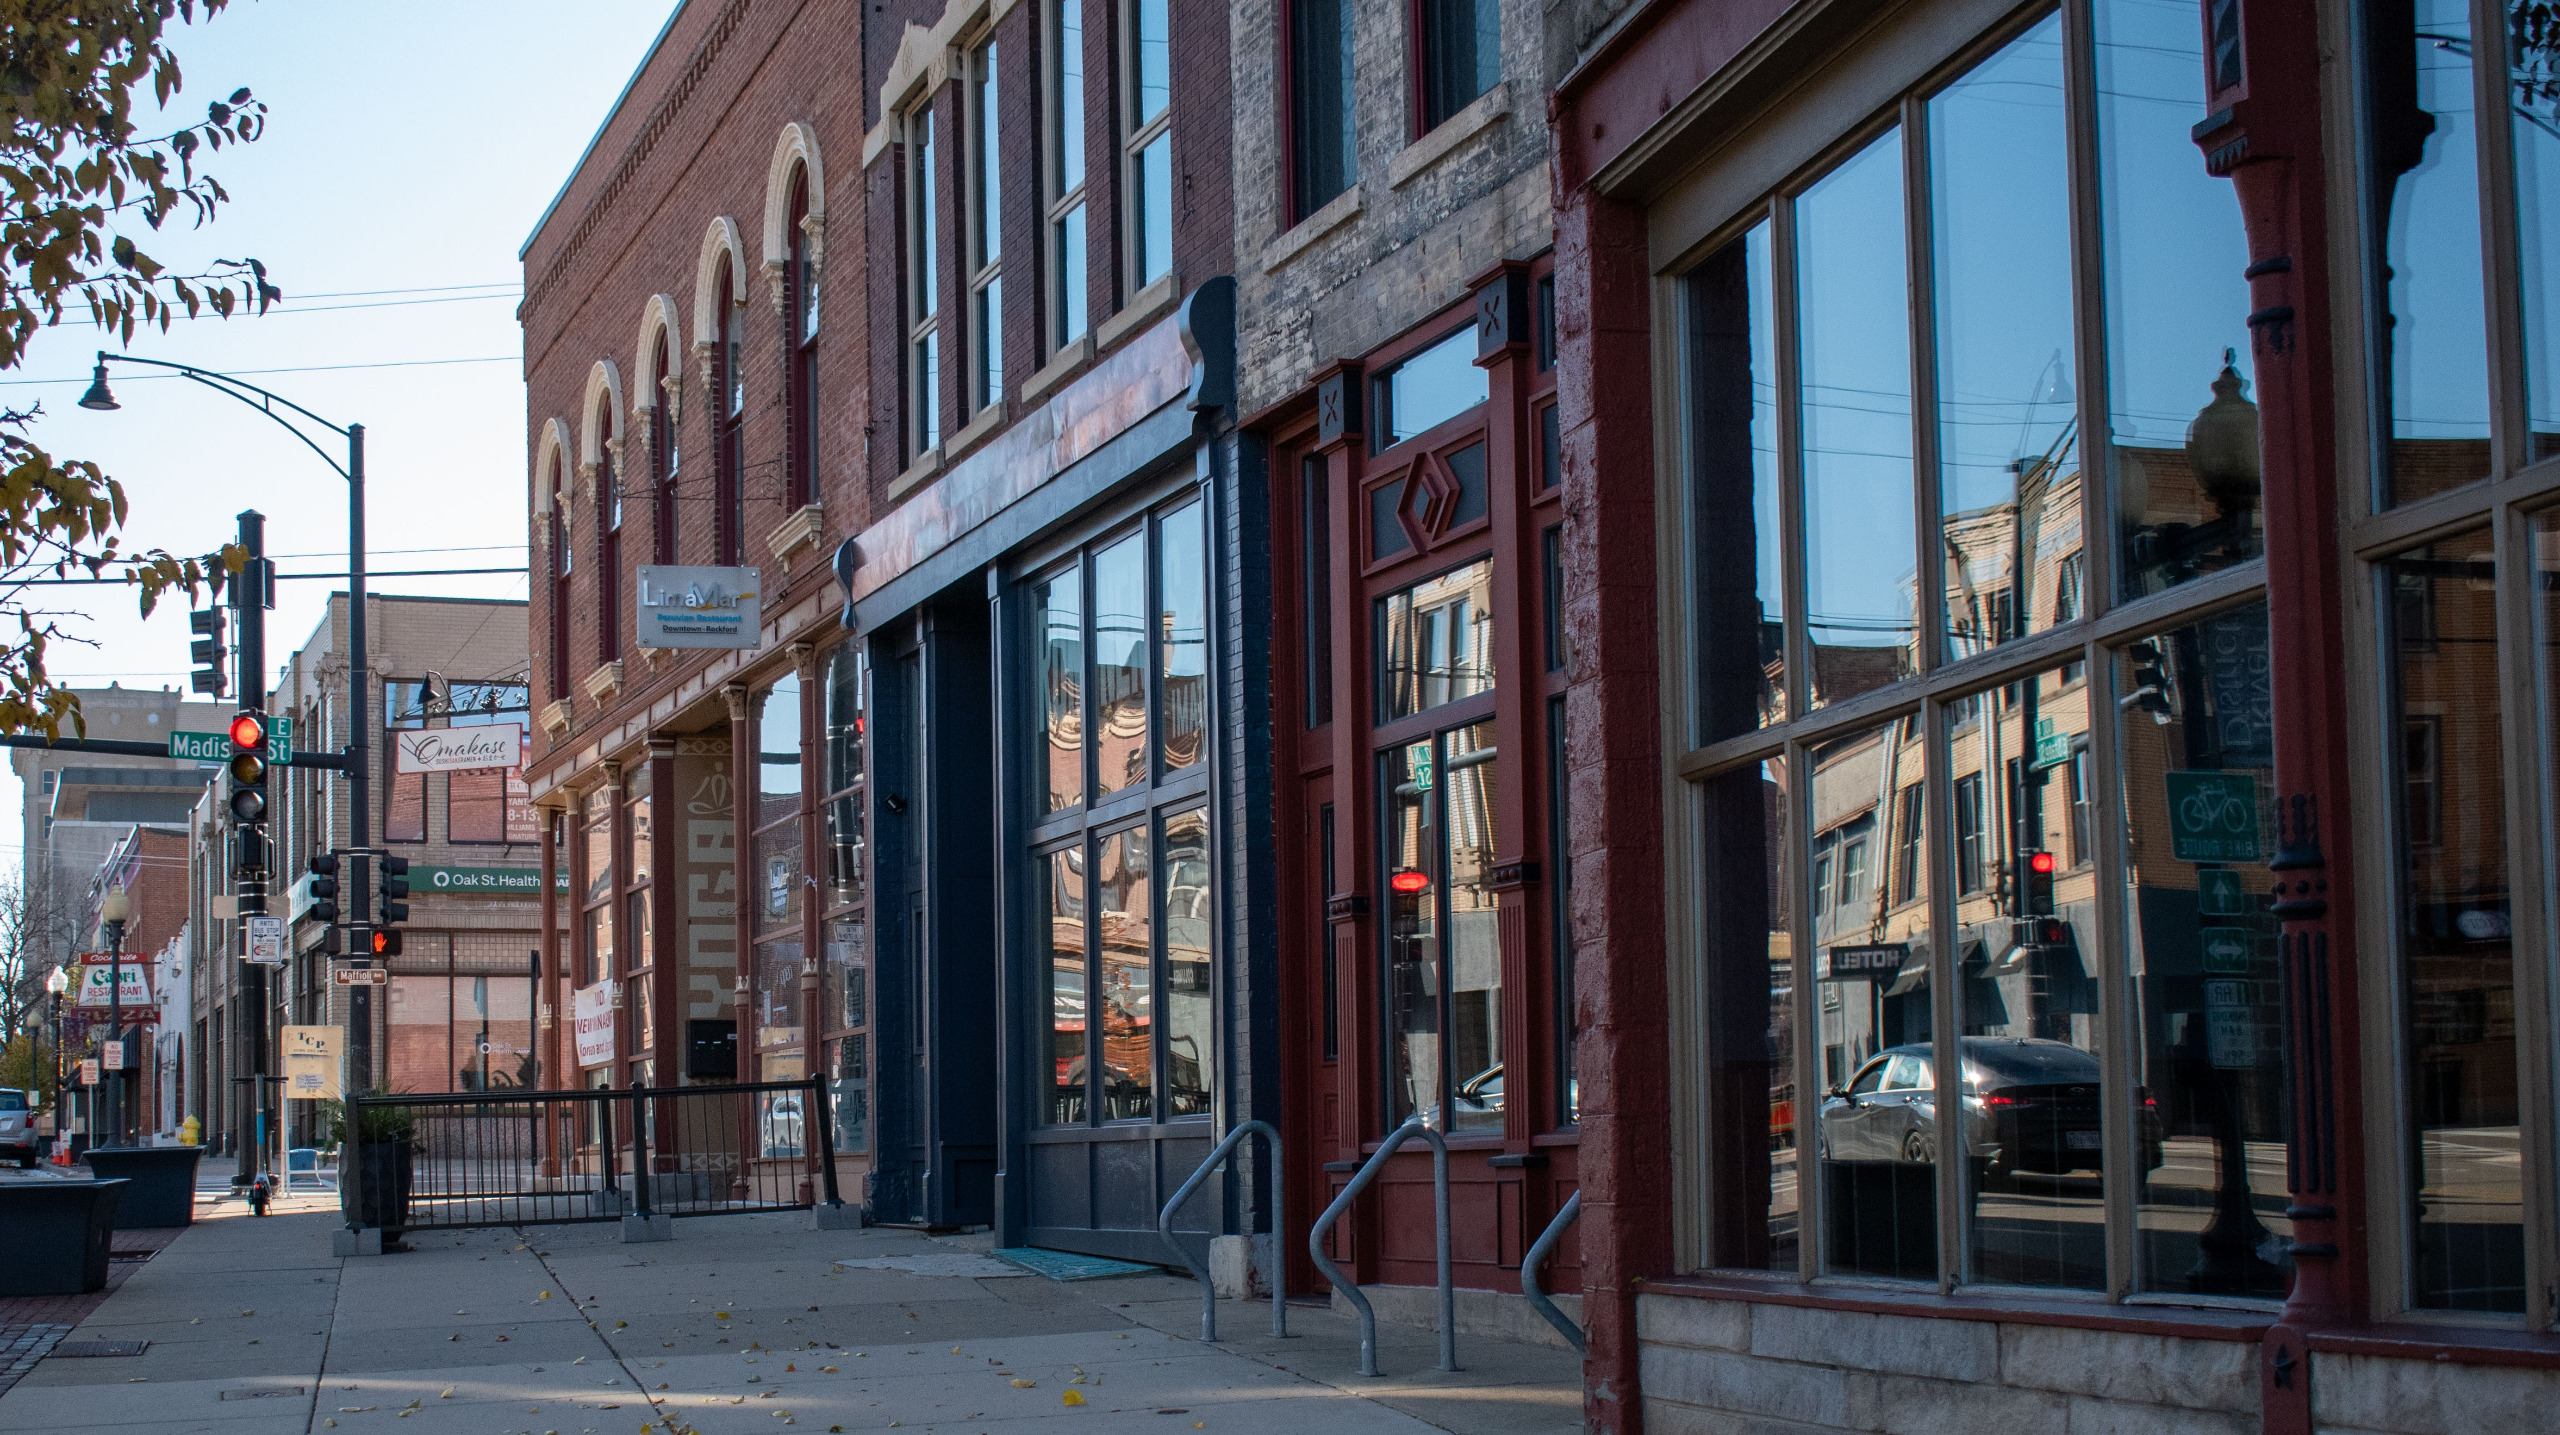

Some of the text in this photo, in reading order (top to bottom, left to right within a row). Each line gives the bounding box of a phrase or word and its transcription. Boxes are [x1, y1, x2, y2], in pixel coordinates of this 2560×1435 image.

[657, 613, 742, 623] Peruvian Restaurant
[278, 719, 287, 734] E
[268, 739, 286, 760] St
[415, 733, 506, 764] Omakase
[452, 874, 541, 887] Oak St. Health
[341, 970, 372, 981] Maffioli
[88, 986, 143, 997] RESTARANT
